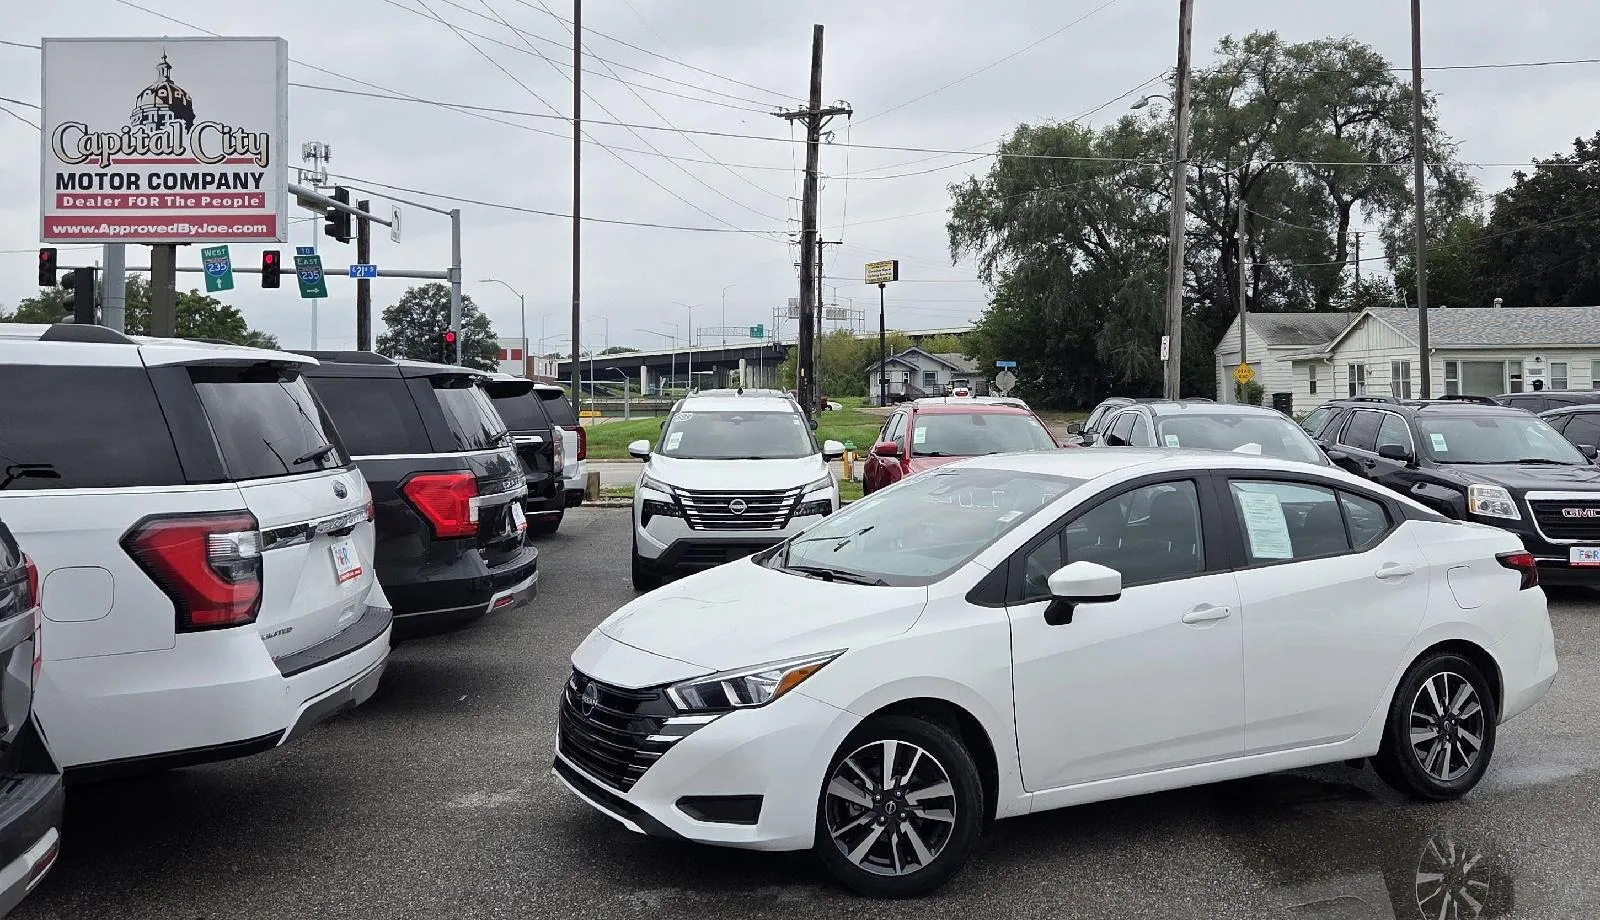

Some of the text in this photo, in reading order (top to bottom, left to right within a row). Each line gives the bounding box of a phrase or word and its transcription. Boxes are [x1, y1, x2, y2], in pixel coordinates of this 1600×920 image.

[51, 121, 270, 168] Capital City
[55, 171, 265, 191] MOTOR COMPANY
[63, 196, 259, 208] Dealer FOR The People
[52, 223, 267, 236] www.ApprovedByJoe.com
[204, 248, 226, 257] WEST
[208, 262, 227, 272] 235
[301, 270, 320, 280] 235
